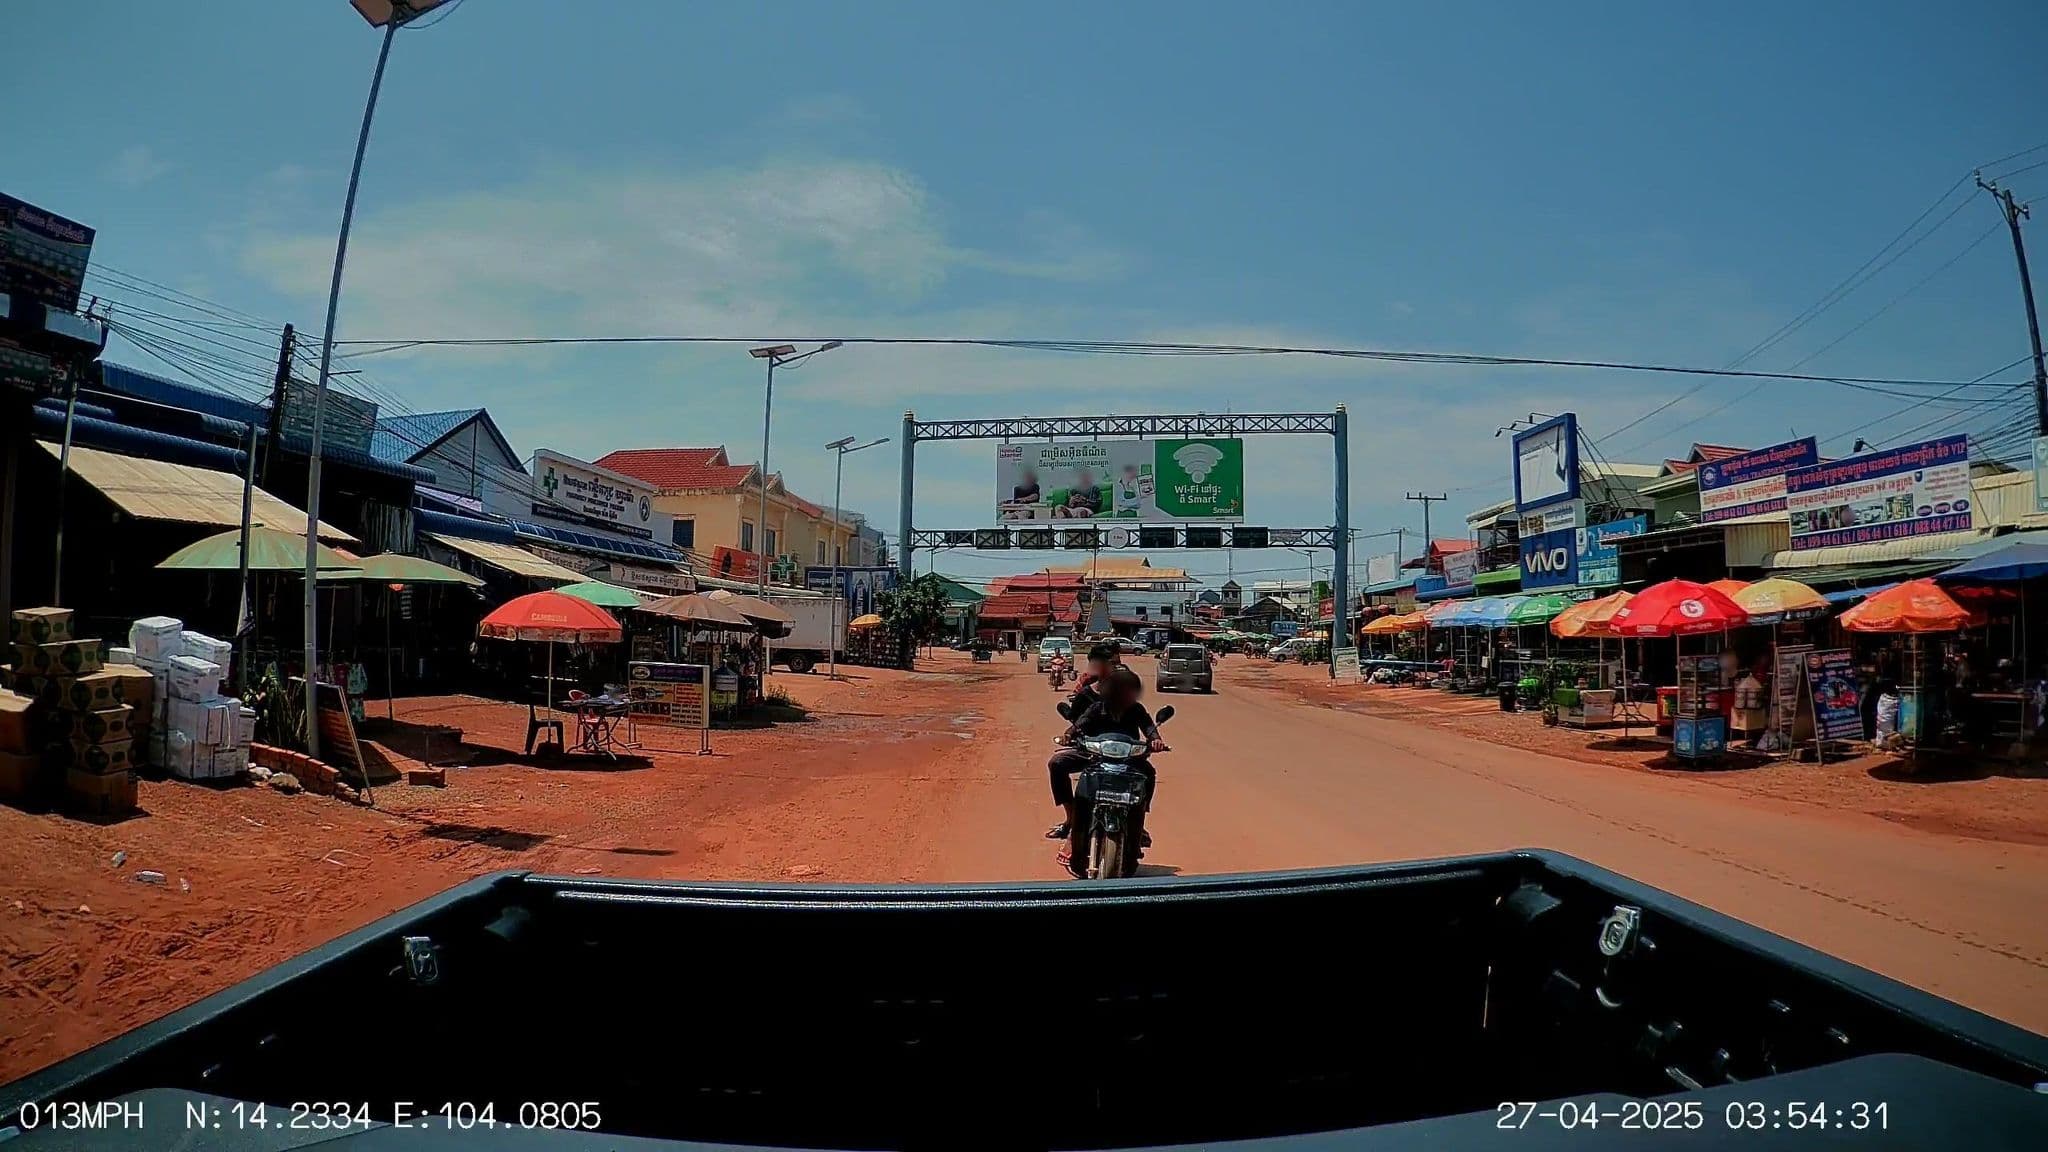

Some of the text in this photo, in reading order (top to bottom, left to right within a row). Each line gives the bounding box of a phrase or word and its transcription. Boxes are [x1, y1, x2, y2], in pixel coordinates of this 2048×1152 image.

[1951, 442, 1967, 456] VIP
[1174, 485, 1199, 494] Wi-Fi
[1188, 495, 1217, 503] Smart
